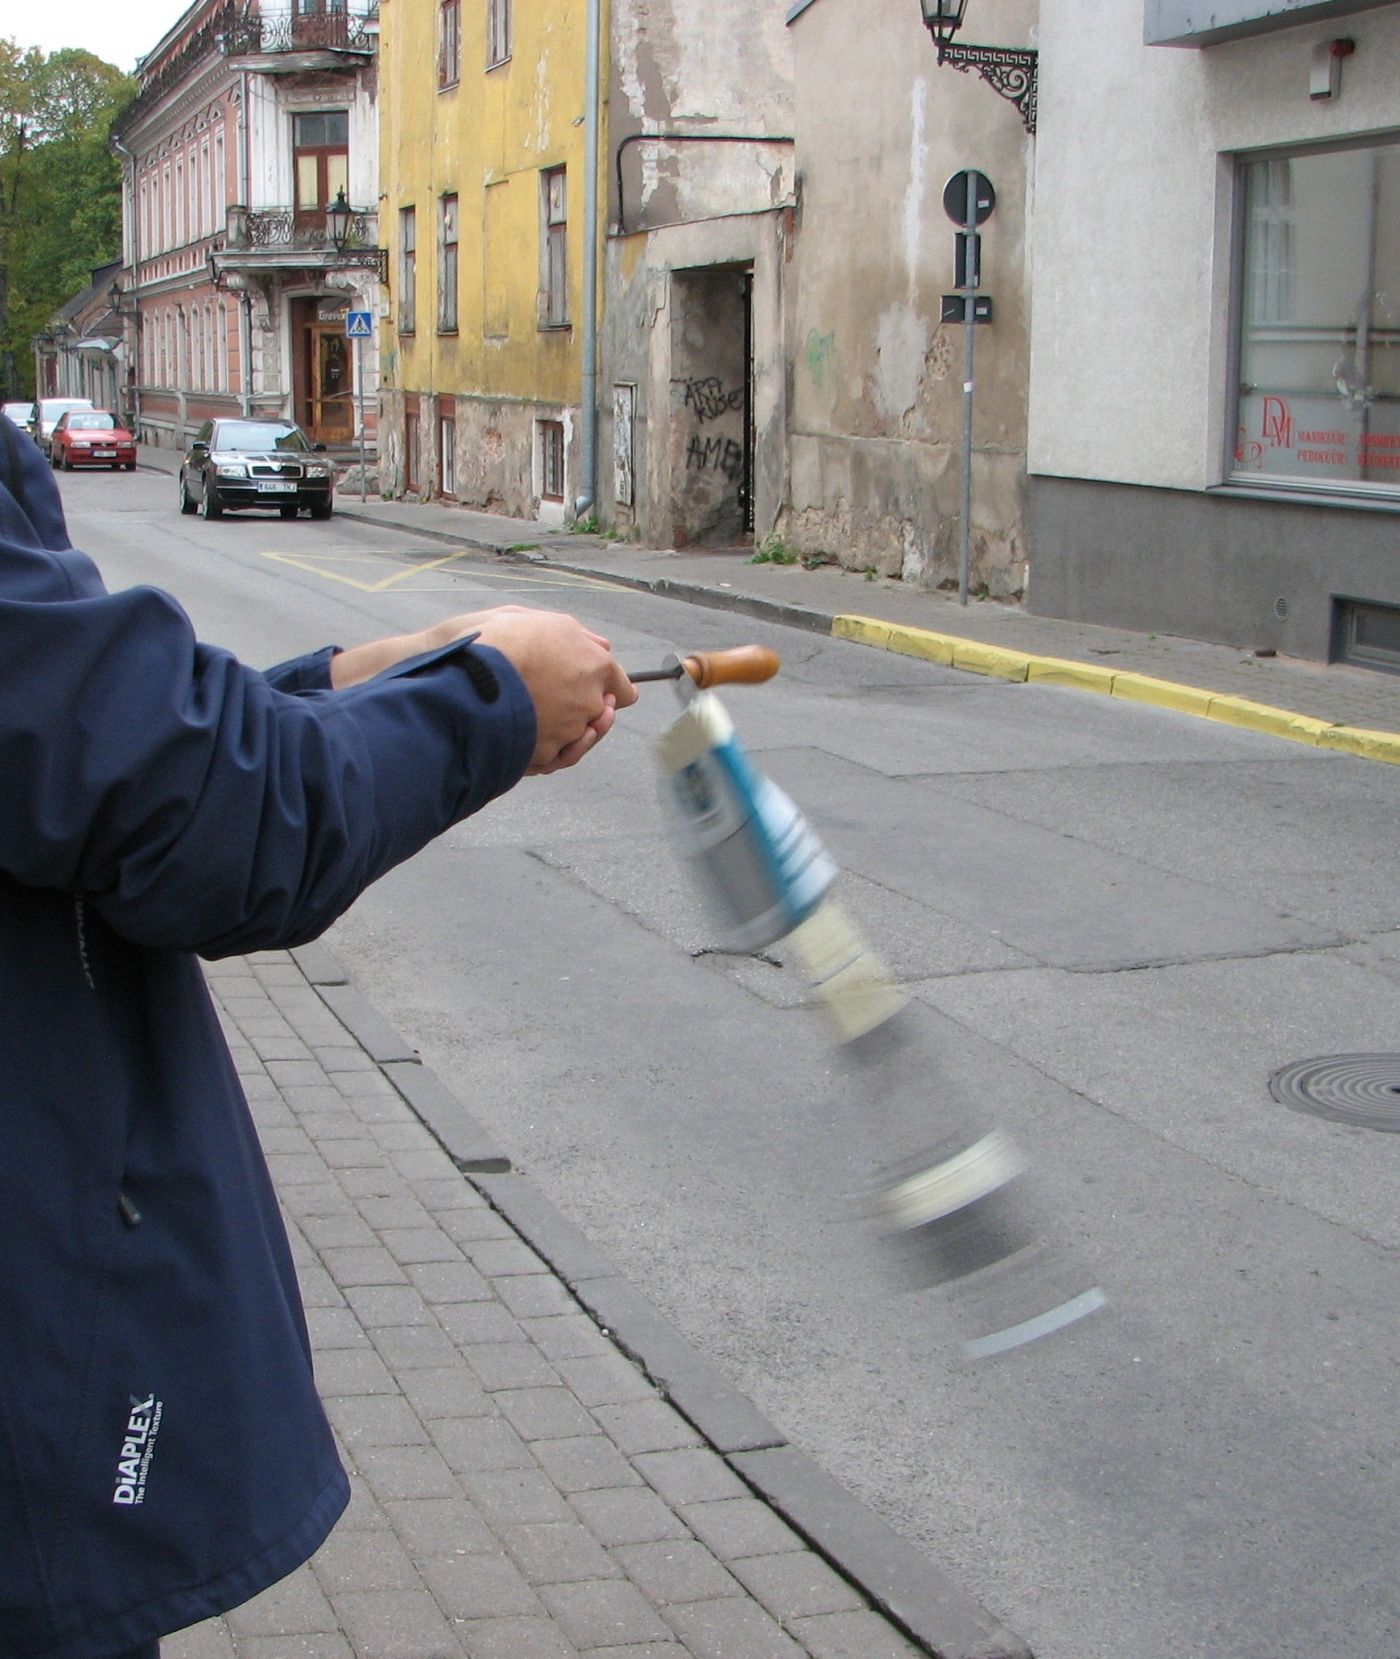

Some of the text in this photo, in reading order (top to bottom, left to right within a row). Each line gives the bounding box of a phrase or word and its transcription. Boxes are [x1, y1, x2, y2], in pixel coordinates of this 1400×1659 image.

[135, 1401, 163, 1504] The Intelligent Texture
